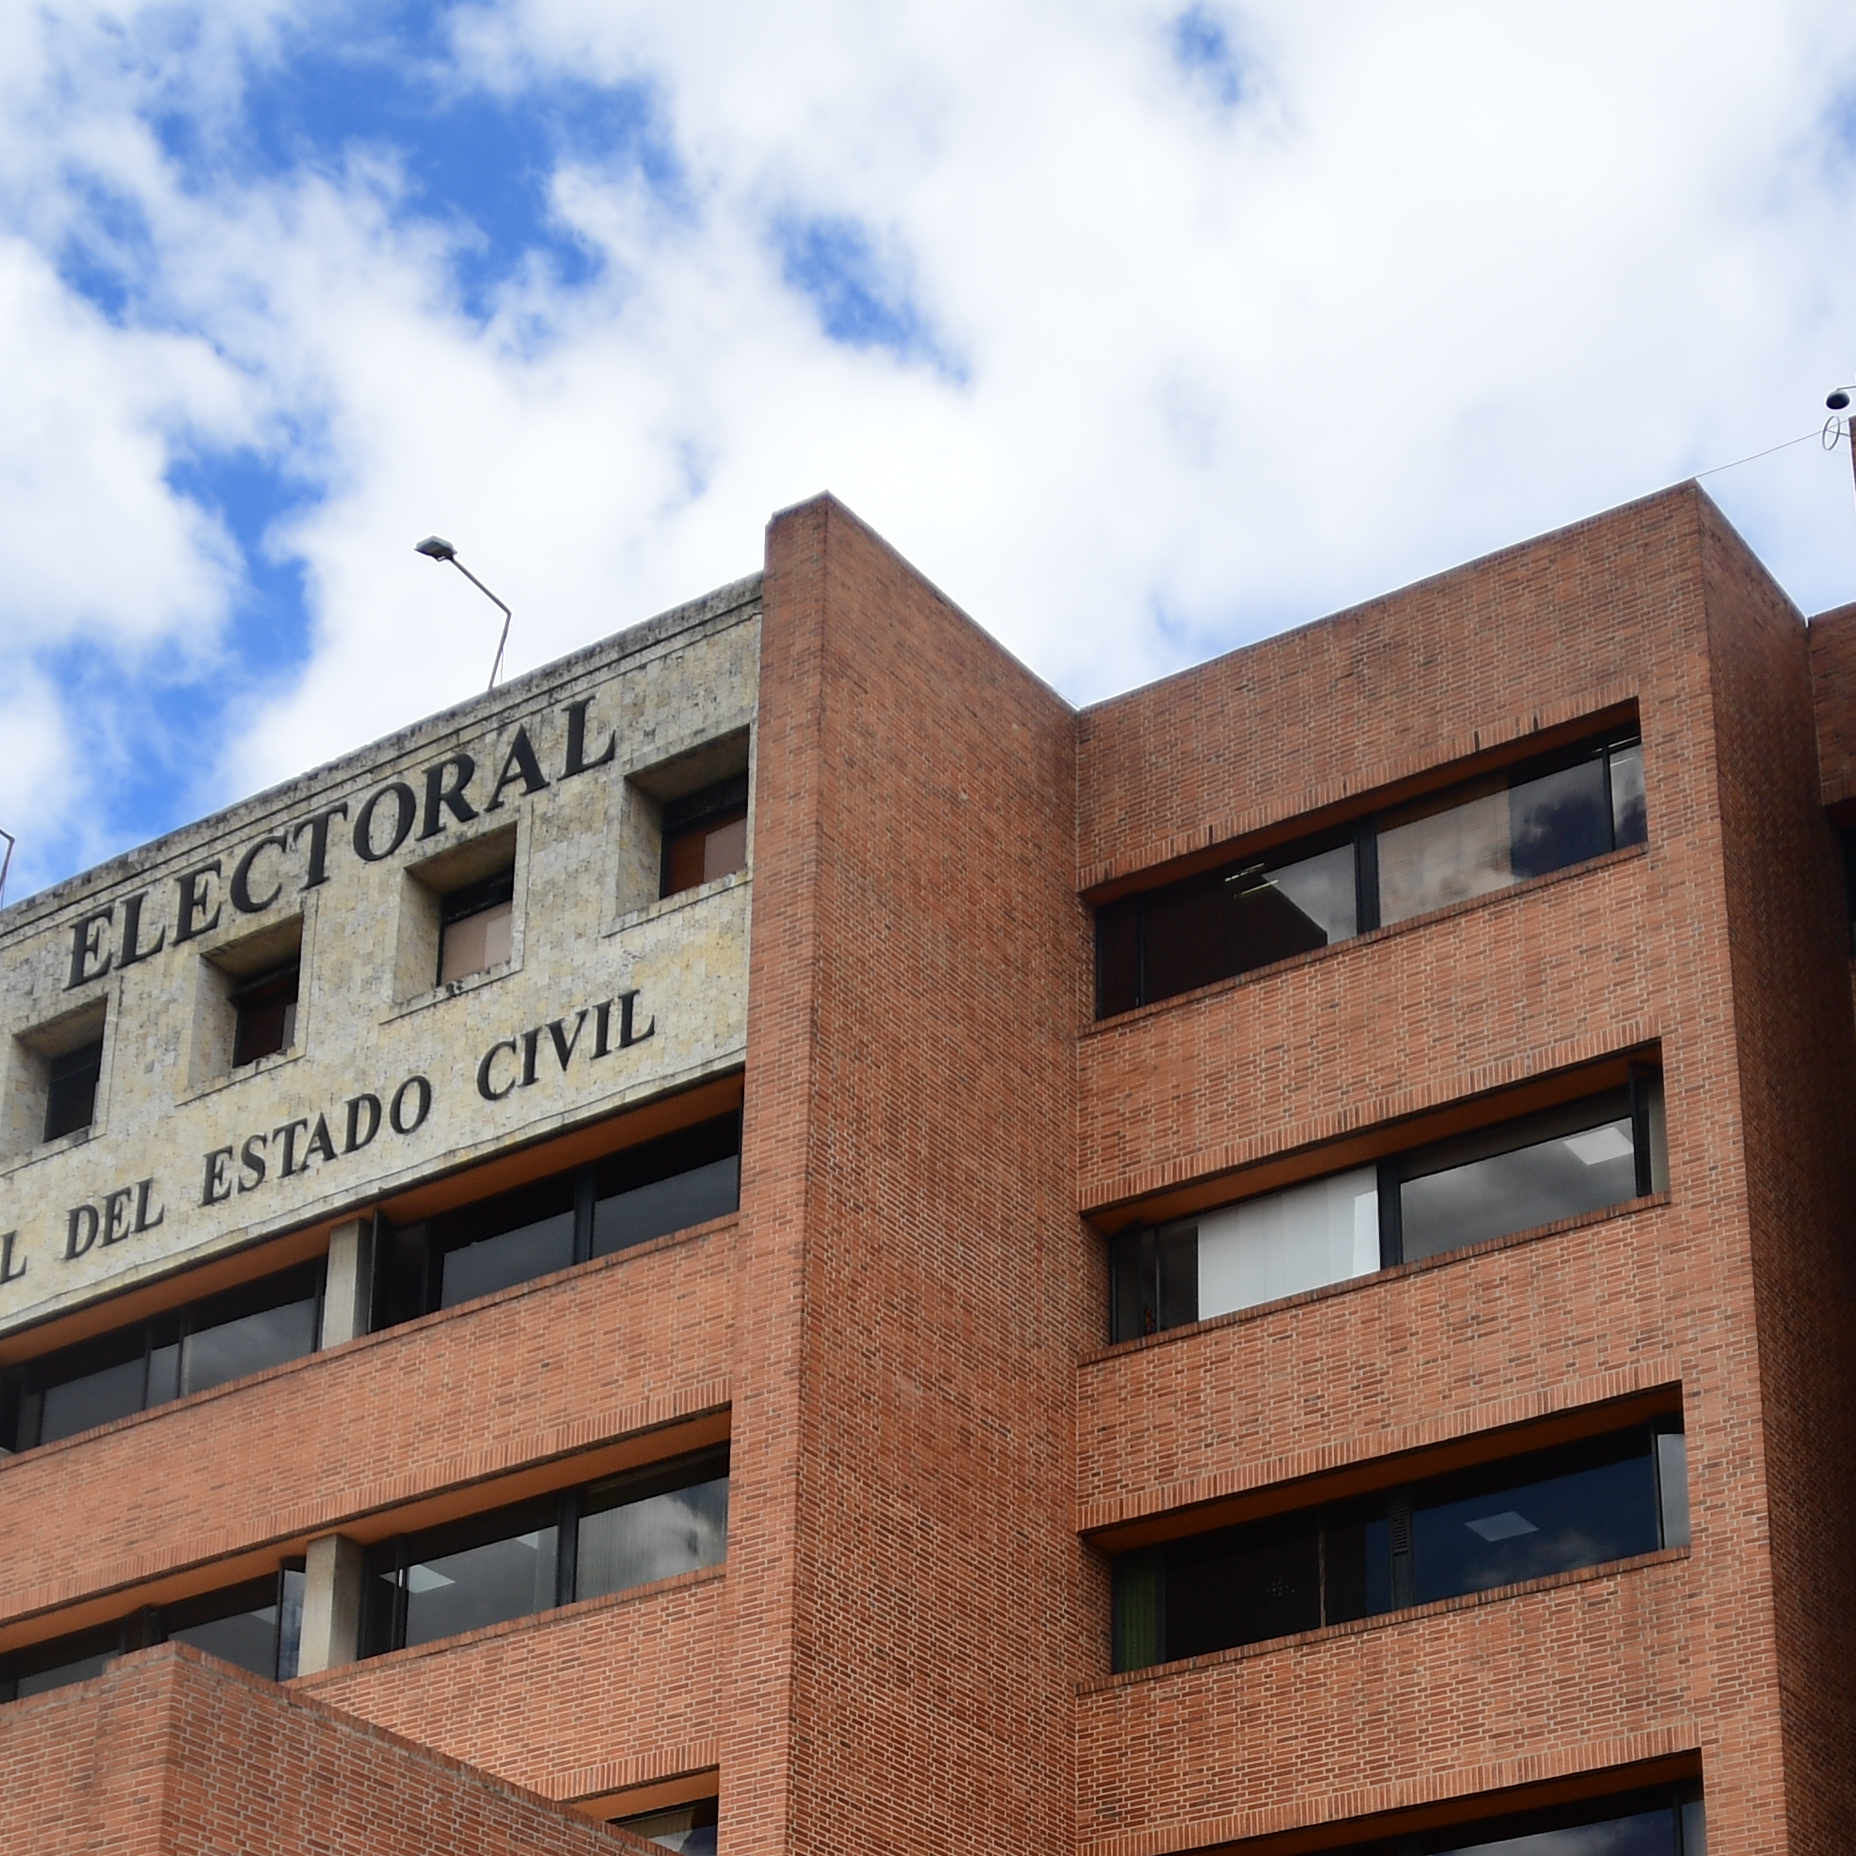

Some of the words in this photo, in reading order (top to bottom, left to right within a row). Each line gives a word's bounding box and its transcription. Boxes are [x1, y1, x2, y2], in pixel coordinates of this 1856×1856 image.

[62, 696, 617, 991] ELECTORAL
[63, 1178, 165, 1261] DEL
[200, 1075, 432, 1207] ESTADO
[476, 989, 656, 1101] CIVIL
